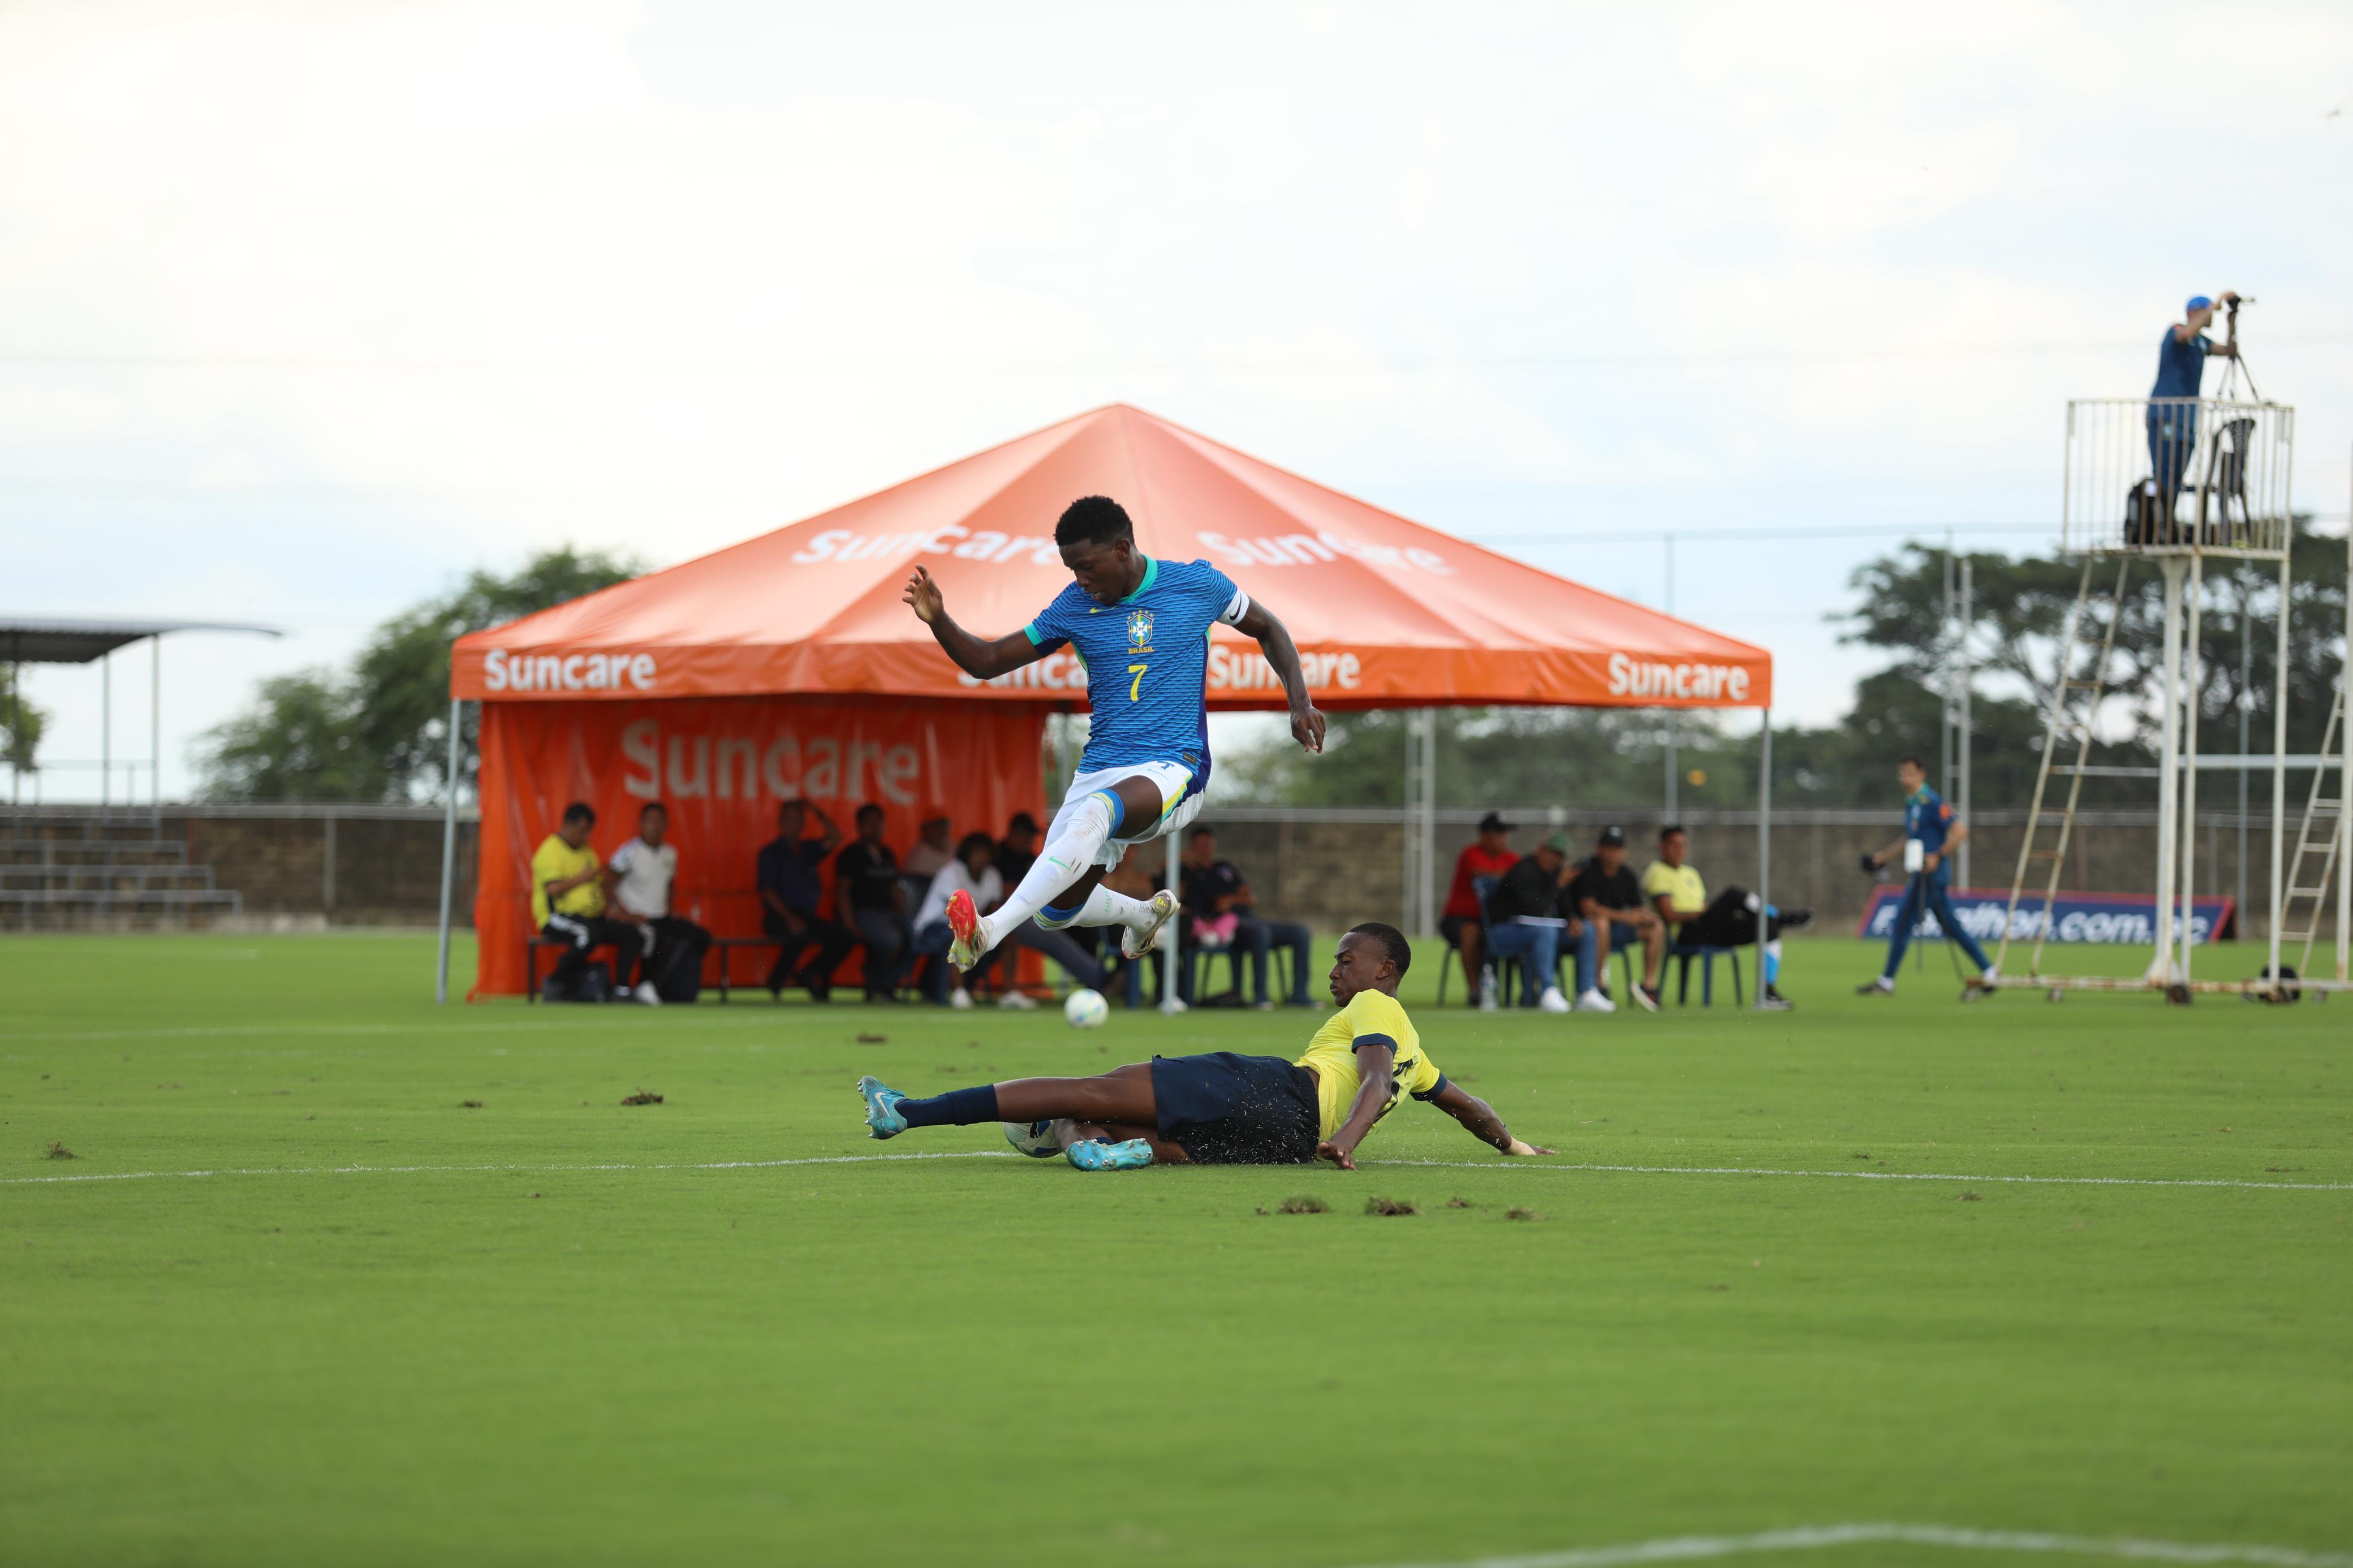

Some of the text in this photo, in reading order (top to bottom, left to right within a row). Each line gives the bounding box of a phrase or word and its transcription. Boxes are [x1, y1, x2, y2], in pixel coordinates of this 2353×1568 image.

[484, 649, 657, 691] Suncare
[1128, 664, 1148, 701] 7
[1208, 644, 1361, 690] Sunare
[1608, 653, 1750, 701] Suncare
[622, 718, 919, 806] Suncare
